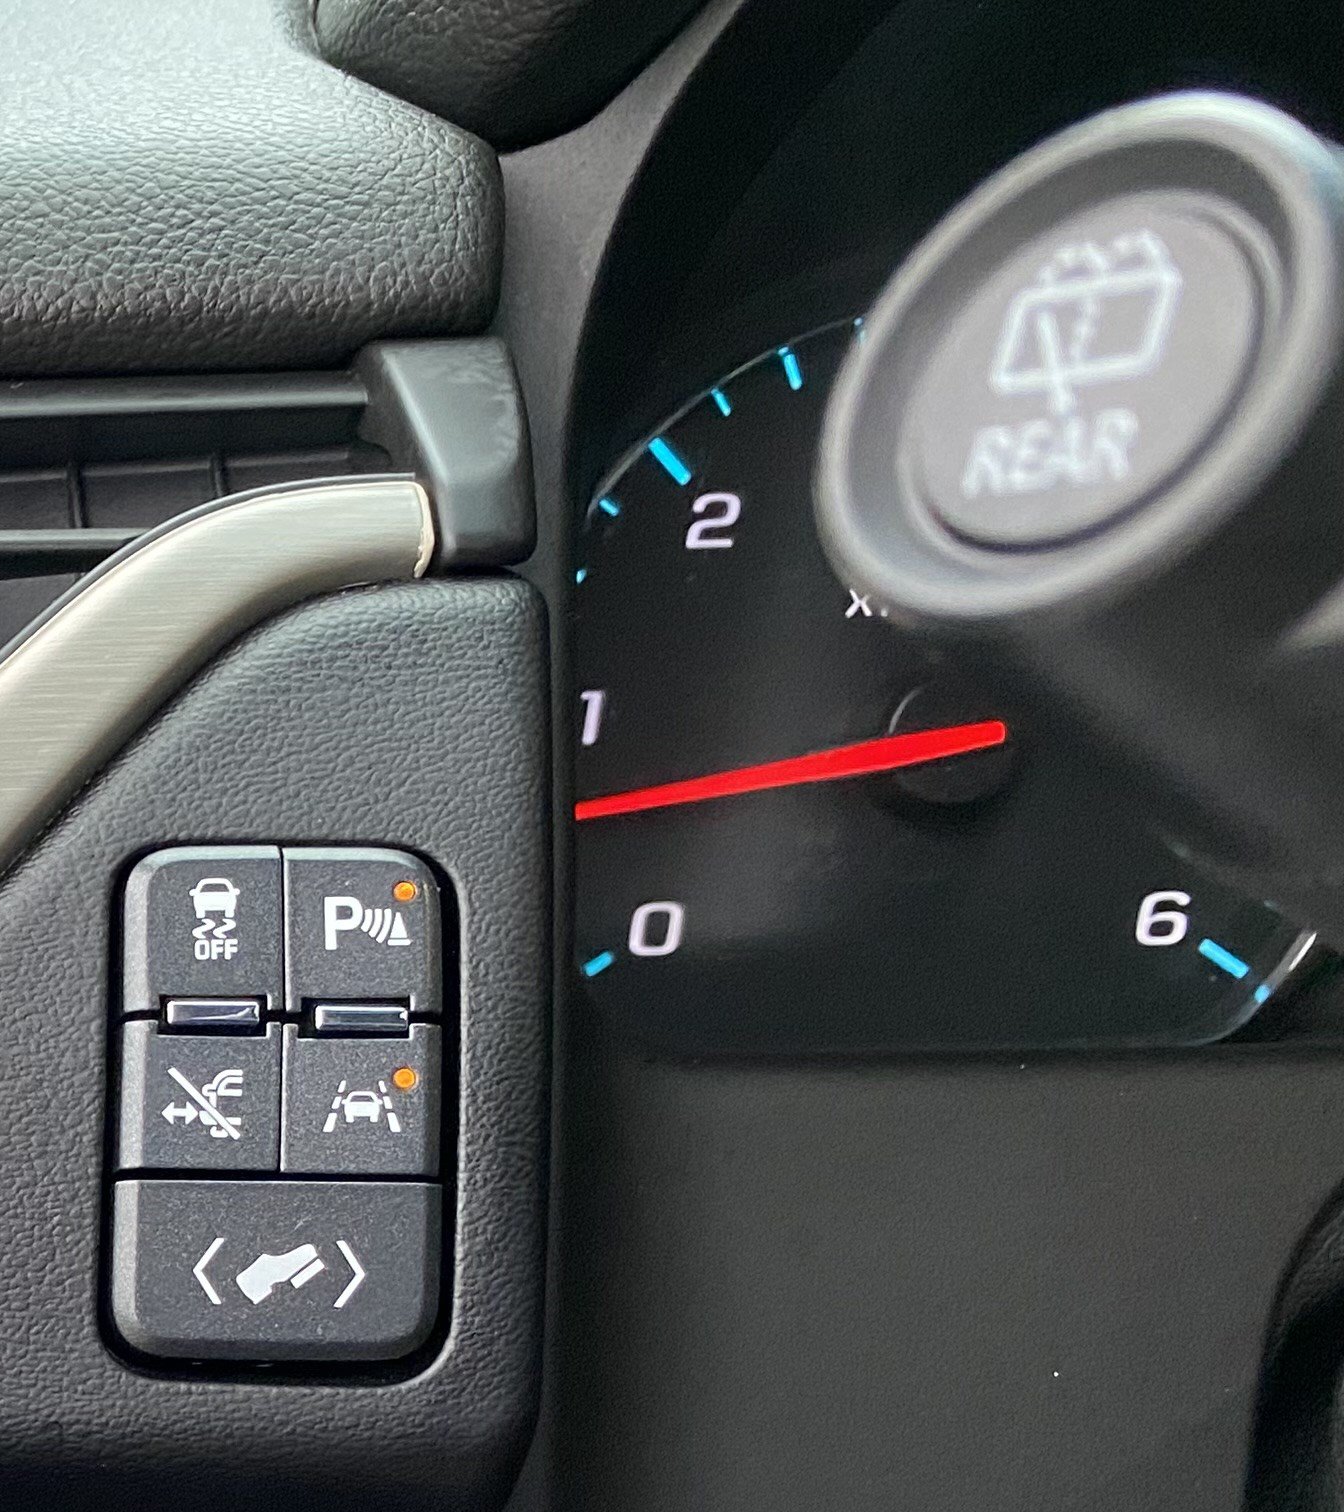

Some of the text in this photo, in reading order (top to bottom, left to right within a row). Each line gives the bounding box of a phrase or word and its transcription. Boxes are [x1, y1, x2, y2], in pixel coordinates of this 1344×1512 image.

[960, 407, 1139, 500] REAR
[685, 492, 742, 549] 2
[579, 690, 607, 745] 1
[323, 896, 360, 951] P
[628, 900, 686, 957] 0
[1135, 889, 1191, 947] 6
[194, 939, 238, 960] OFF
